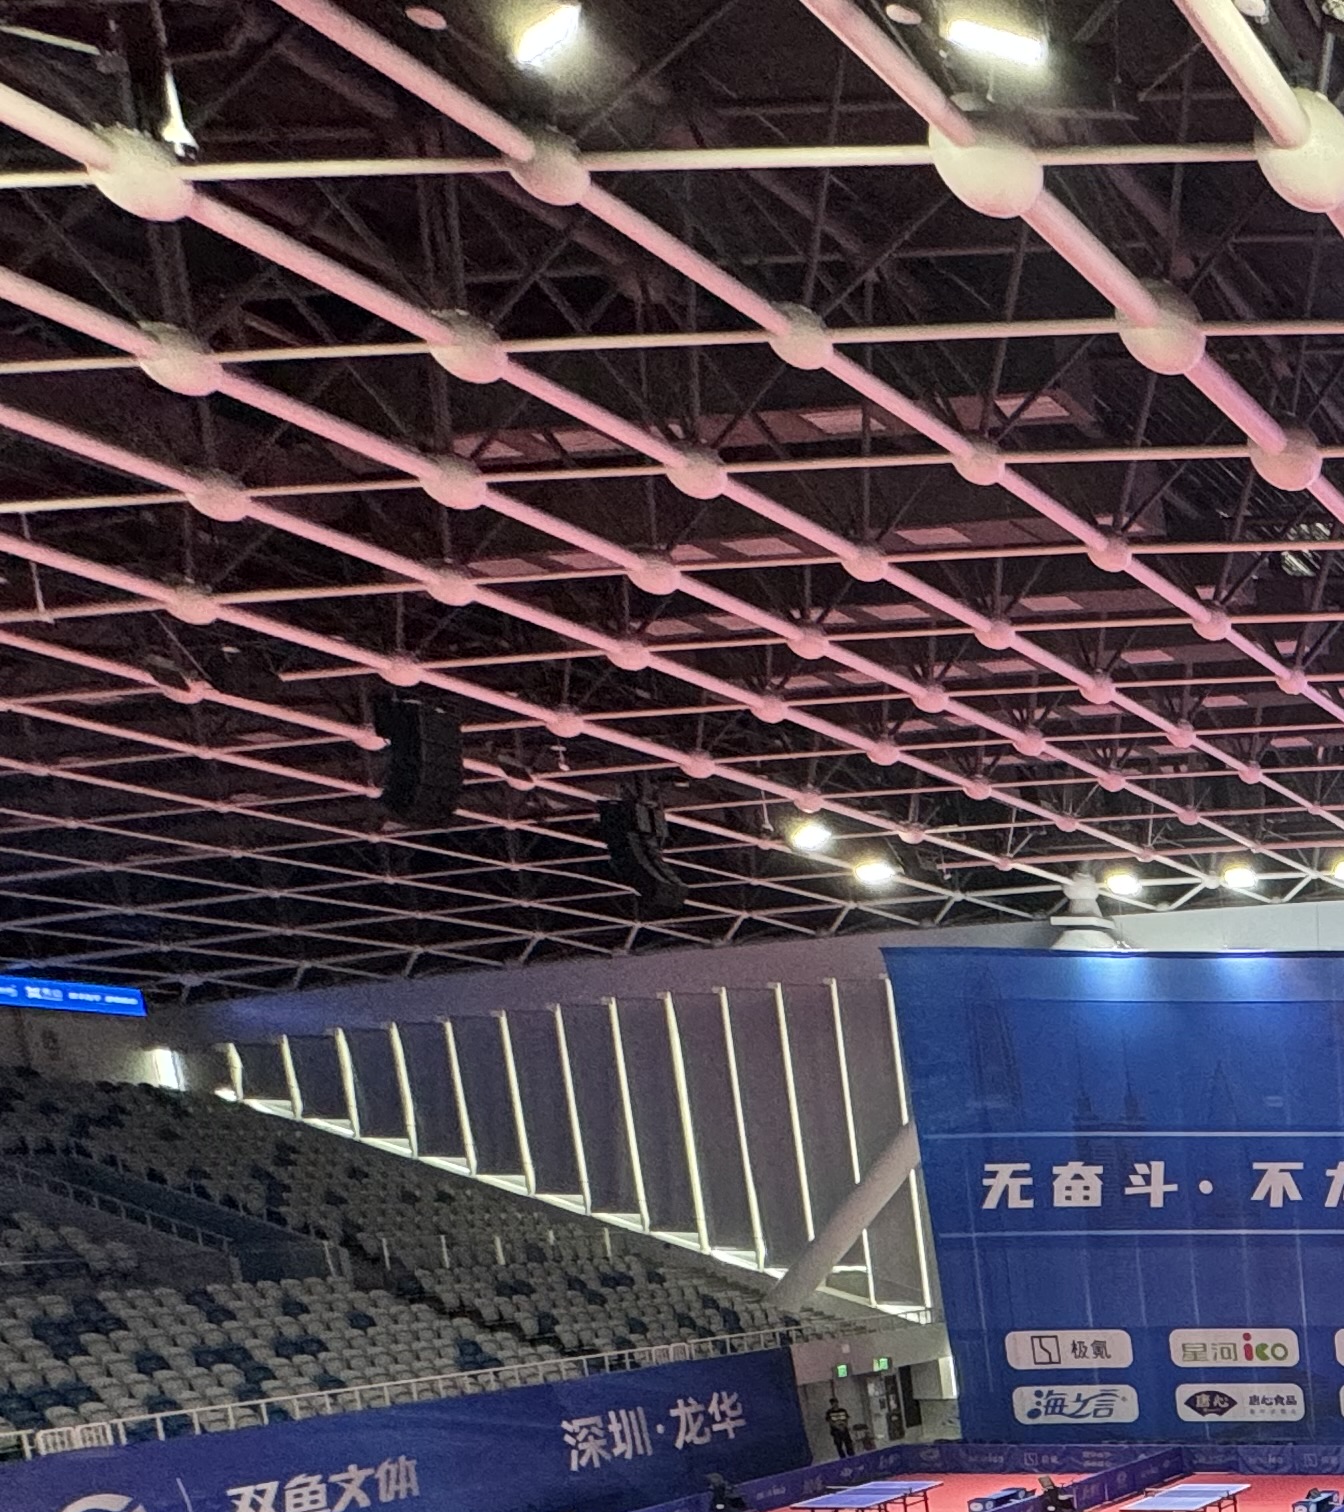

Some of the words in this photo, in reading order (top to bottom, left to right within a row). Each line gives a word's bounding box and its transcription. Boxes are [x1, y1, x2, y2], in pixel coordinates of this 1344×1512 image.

[1071, 1339, 1112, 1361] 极氪
[561, 1391, 747, 1471] 深圳·龙华
